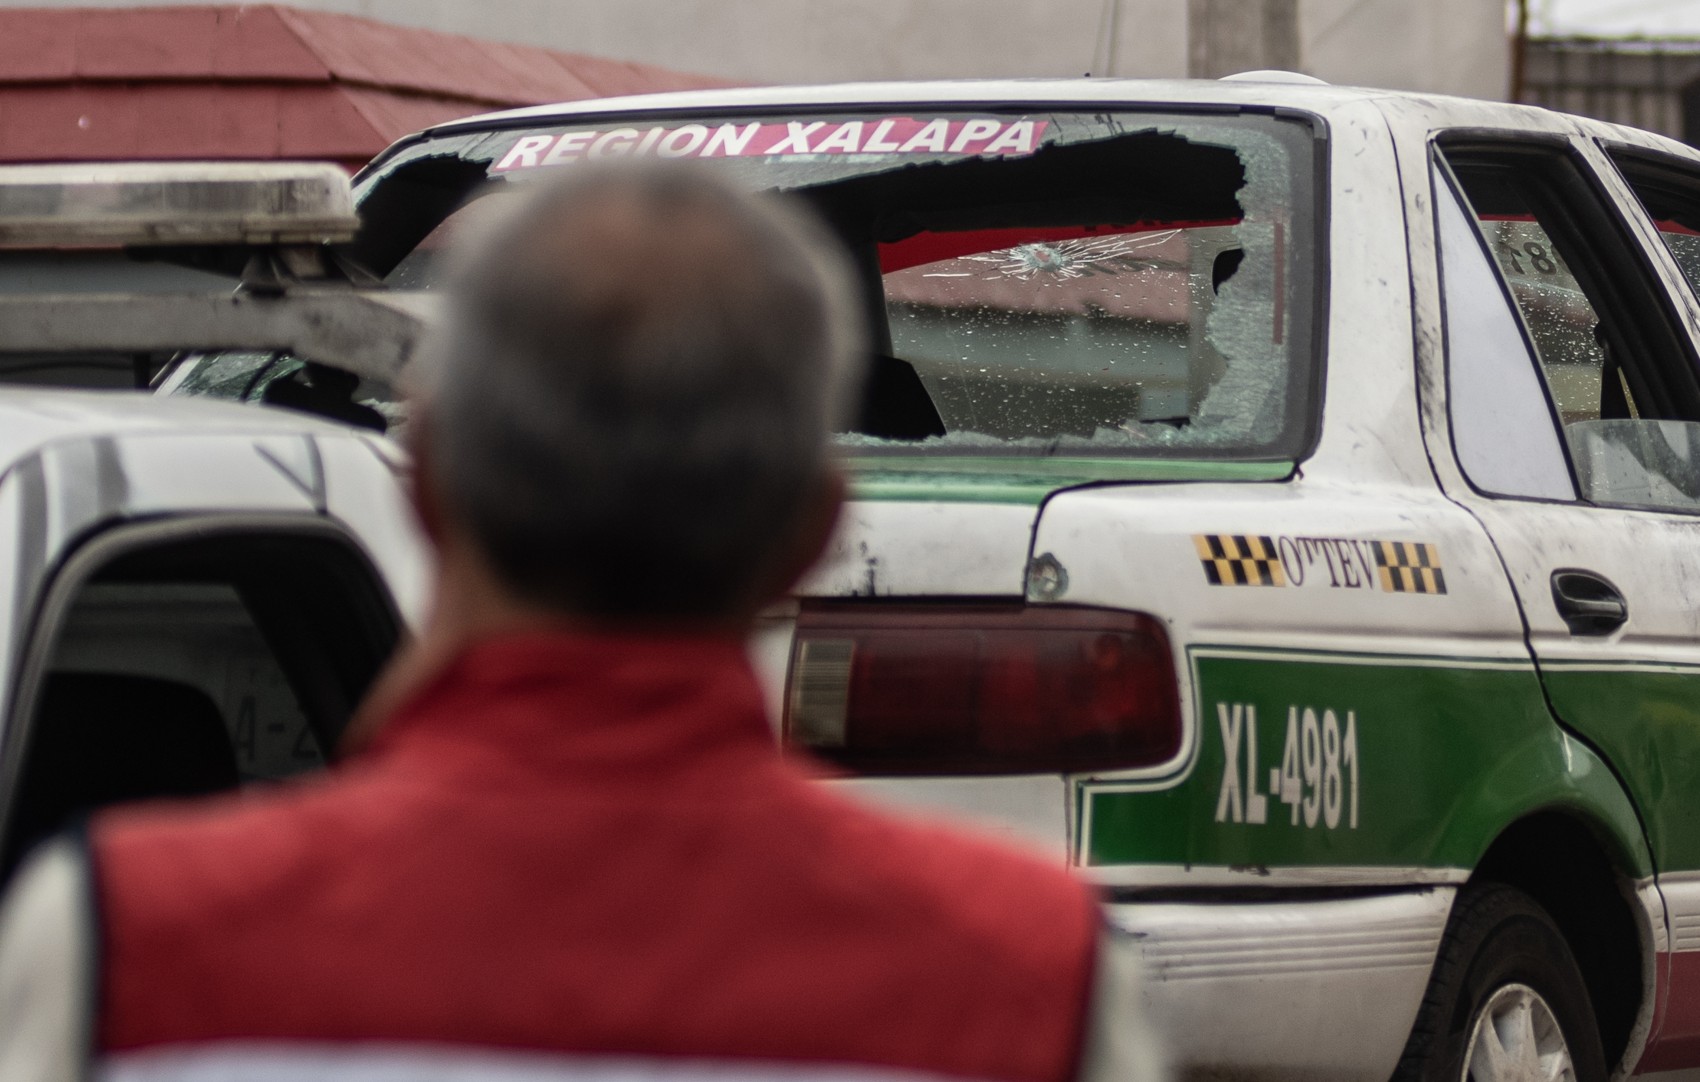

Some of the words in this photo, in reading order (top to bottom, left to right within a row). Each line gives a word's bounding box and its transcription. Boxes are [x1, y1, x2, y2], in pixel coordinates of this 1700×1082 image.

[496, 121, 762, 169] REGION
[763, 118, 1035, 155] XALAPA
[1214, 703, 1358, 829] XL-4981
